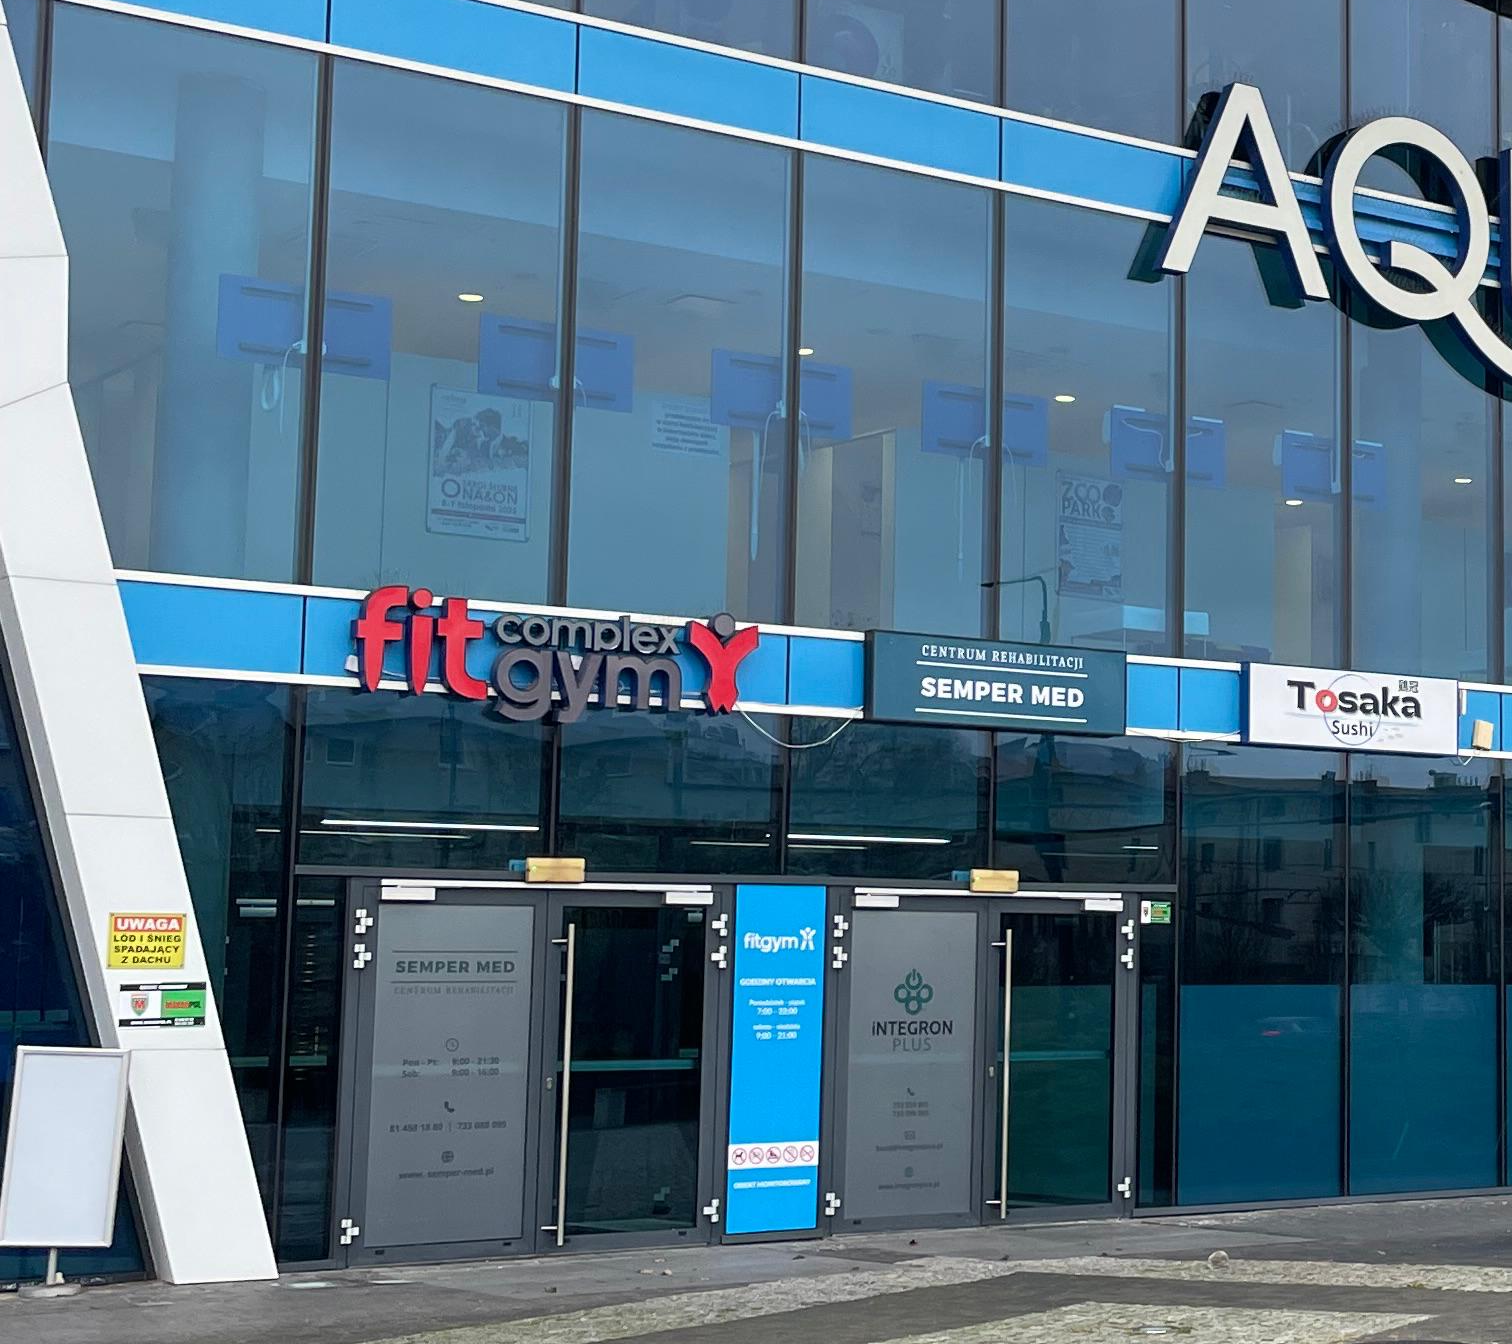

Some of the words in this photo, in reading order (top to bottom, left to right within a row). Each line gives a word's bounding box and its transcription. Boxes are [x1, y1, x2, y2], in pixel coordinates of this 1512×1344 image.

[353, 585, 487, 700] fit
[492, 614, 681, 655] complex
[921, 644, 986, 661] CENTRUM
[992, 650, 1084, 671] REHABILITACJI
[487, 648, 682, 723] gym
[921, 677, 1023, 704] SEMPER
[1031, 685, 1085, 708] MED
[1287, 679, 1422, 719] Tosaka
[1332, 719, 1374, 738] Sushi
[116, 918, 180, 931] UWAGA
[147, 934, 182, 943] ŚNIEG
[743, 932, 798, 953] fitgym
[114, 945, 180, 954] SPADAJĄCY
[121, 956, 129, 964] Z
[132, 956, 171, 964] DACHU
[395, 961, 470, 974] SEMPER
[476, 960, 515, 974] MED
[394, 986, 441, 995] CENTRUM
[892, 1038, 932, 1052] PLUS
